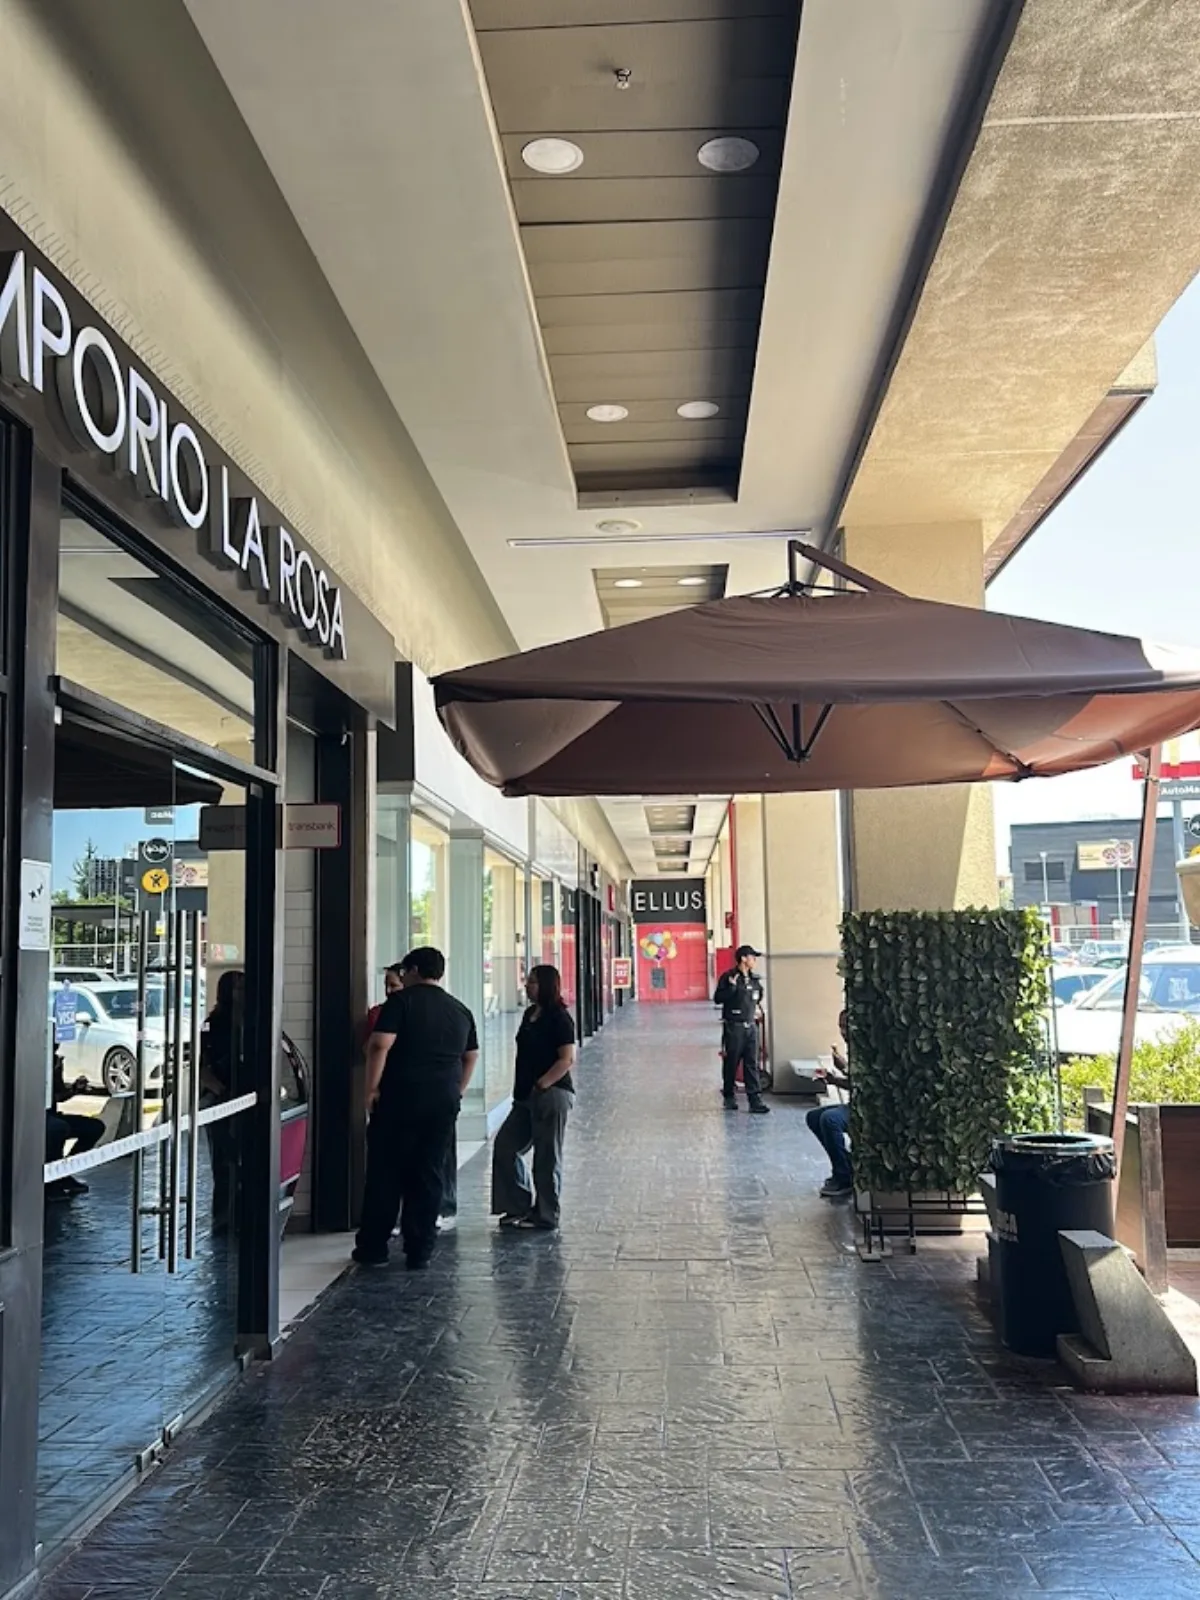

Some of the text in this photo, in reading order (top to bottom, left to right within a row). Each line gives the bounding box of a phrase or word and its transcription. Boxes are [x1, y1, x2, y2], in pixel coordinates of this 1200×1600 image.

[221, 465, 270, 590] LA
[279, 526, 347, 660] ROSA
[288, 820, 336, 832] transbank
[635, 891, 703, 911] ELLUS
